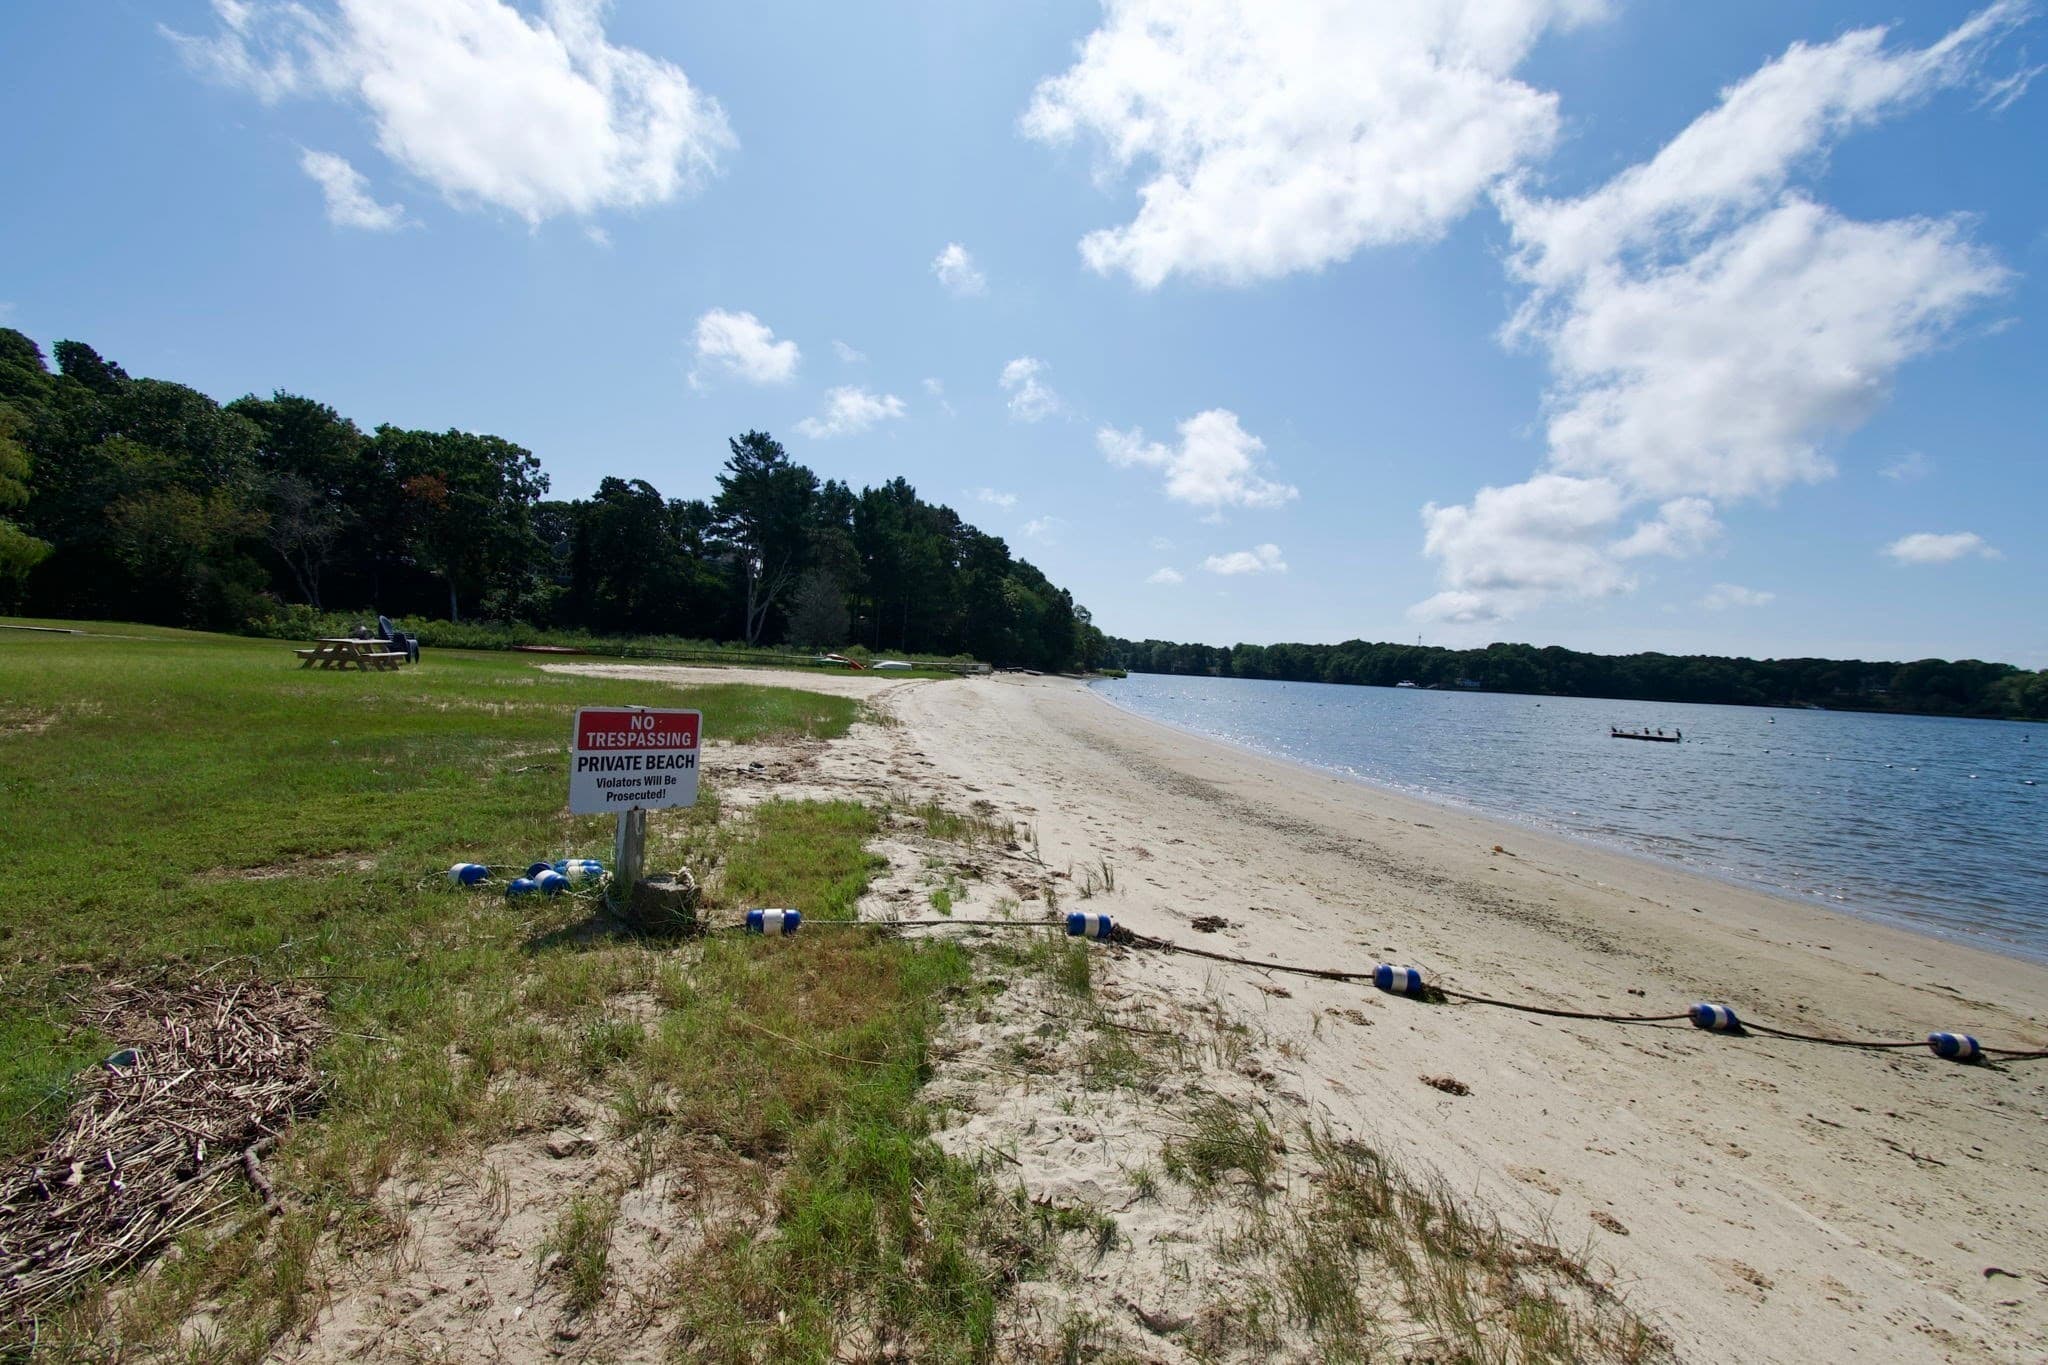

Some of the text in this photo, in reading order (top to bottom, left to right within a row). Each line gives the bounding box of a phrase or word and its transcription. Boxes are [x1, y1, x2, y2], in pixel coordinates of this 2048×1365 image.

[631, 716, 655, 730] NO
[587, 732, 692, 747] TRESPASSING
[577, 754, 695, 772] PRIVATE BEACH
[596, 775, 677, 789] Violators Will Be
[606, 789, 666, 802] Prosecuted!
